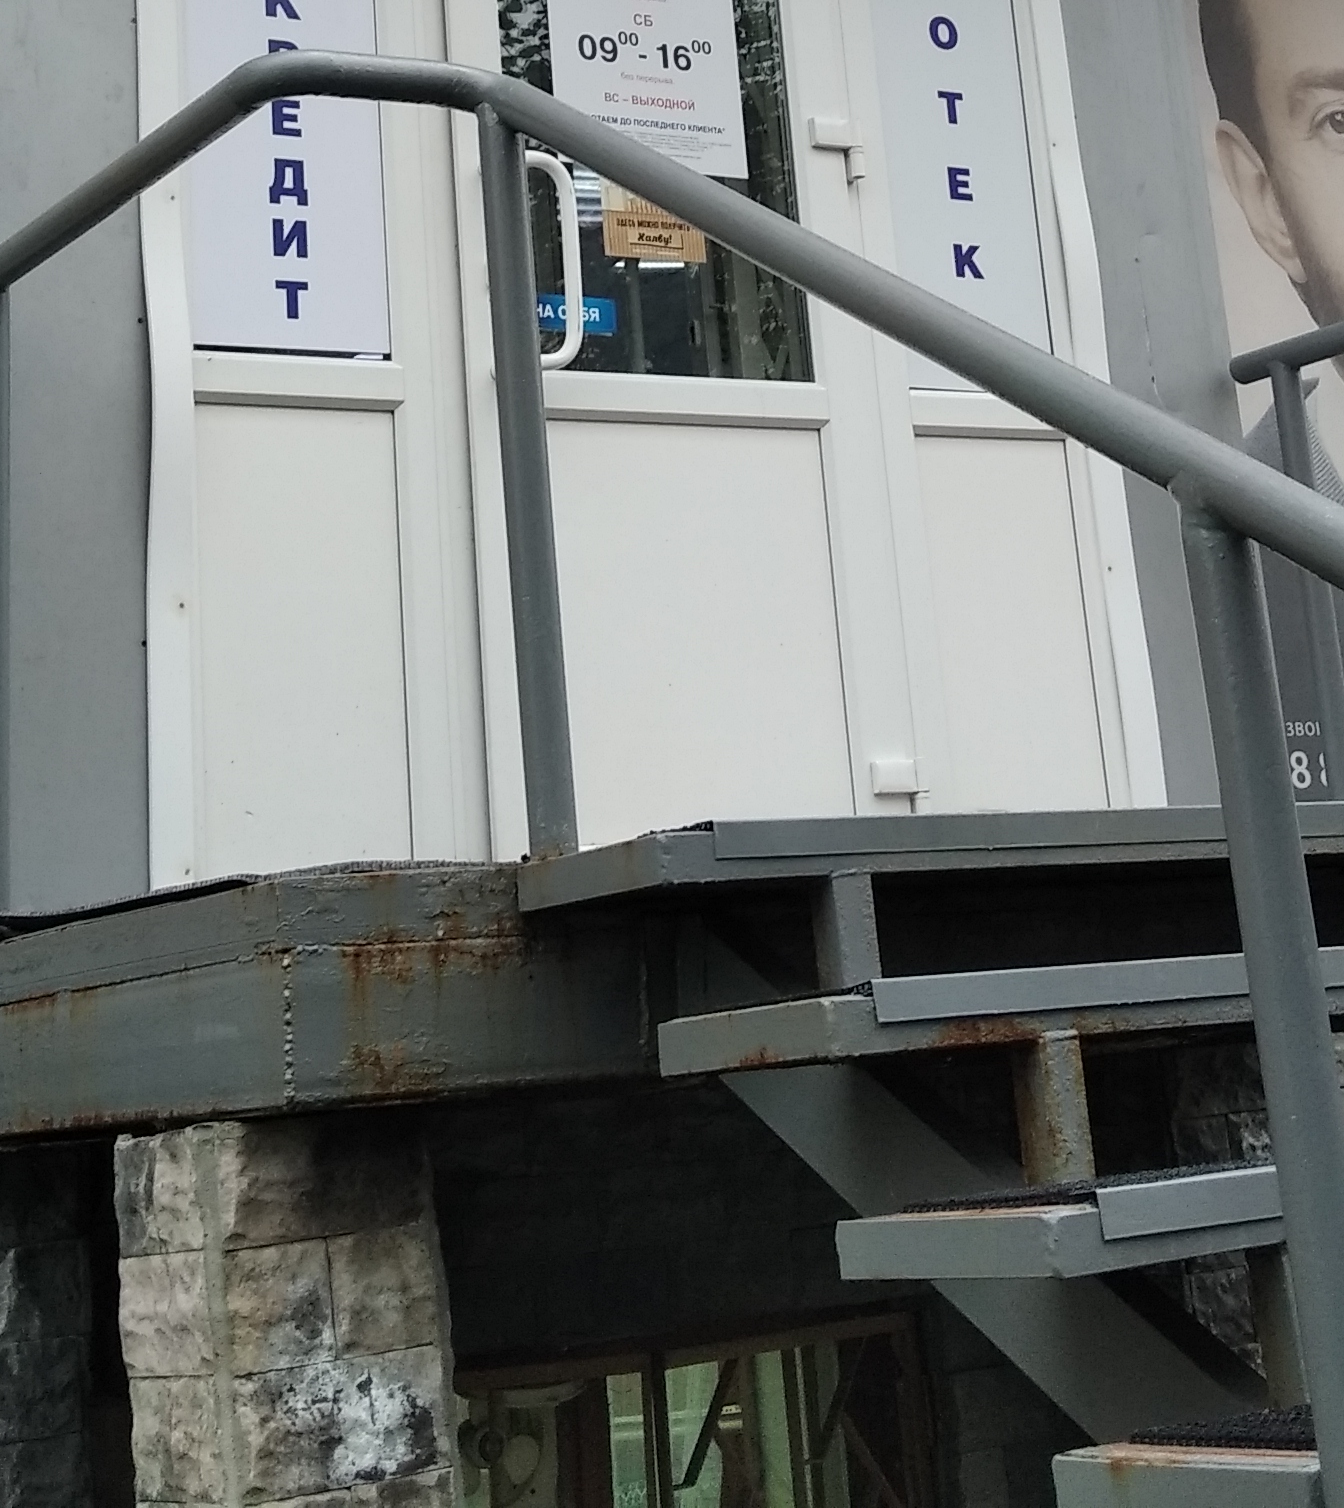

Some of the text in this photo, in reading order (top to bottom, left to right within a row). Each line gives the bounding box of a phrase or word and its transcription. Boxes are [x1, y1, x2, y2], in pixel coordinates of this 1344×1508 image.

[632, 12, 654, 28] СБ
[604, 91, 696, 112] ВС ВЫХОДНОЙ
[619, 116, 632, 127] ДО
[632, 118, 687, 133] ПОСЛЕДНЕГО
[637, 232, 673, 246] Халву!
[1289, 750, 1312, 789] 8
